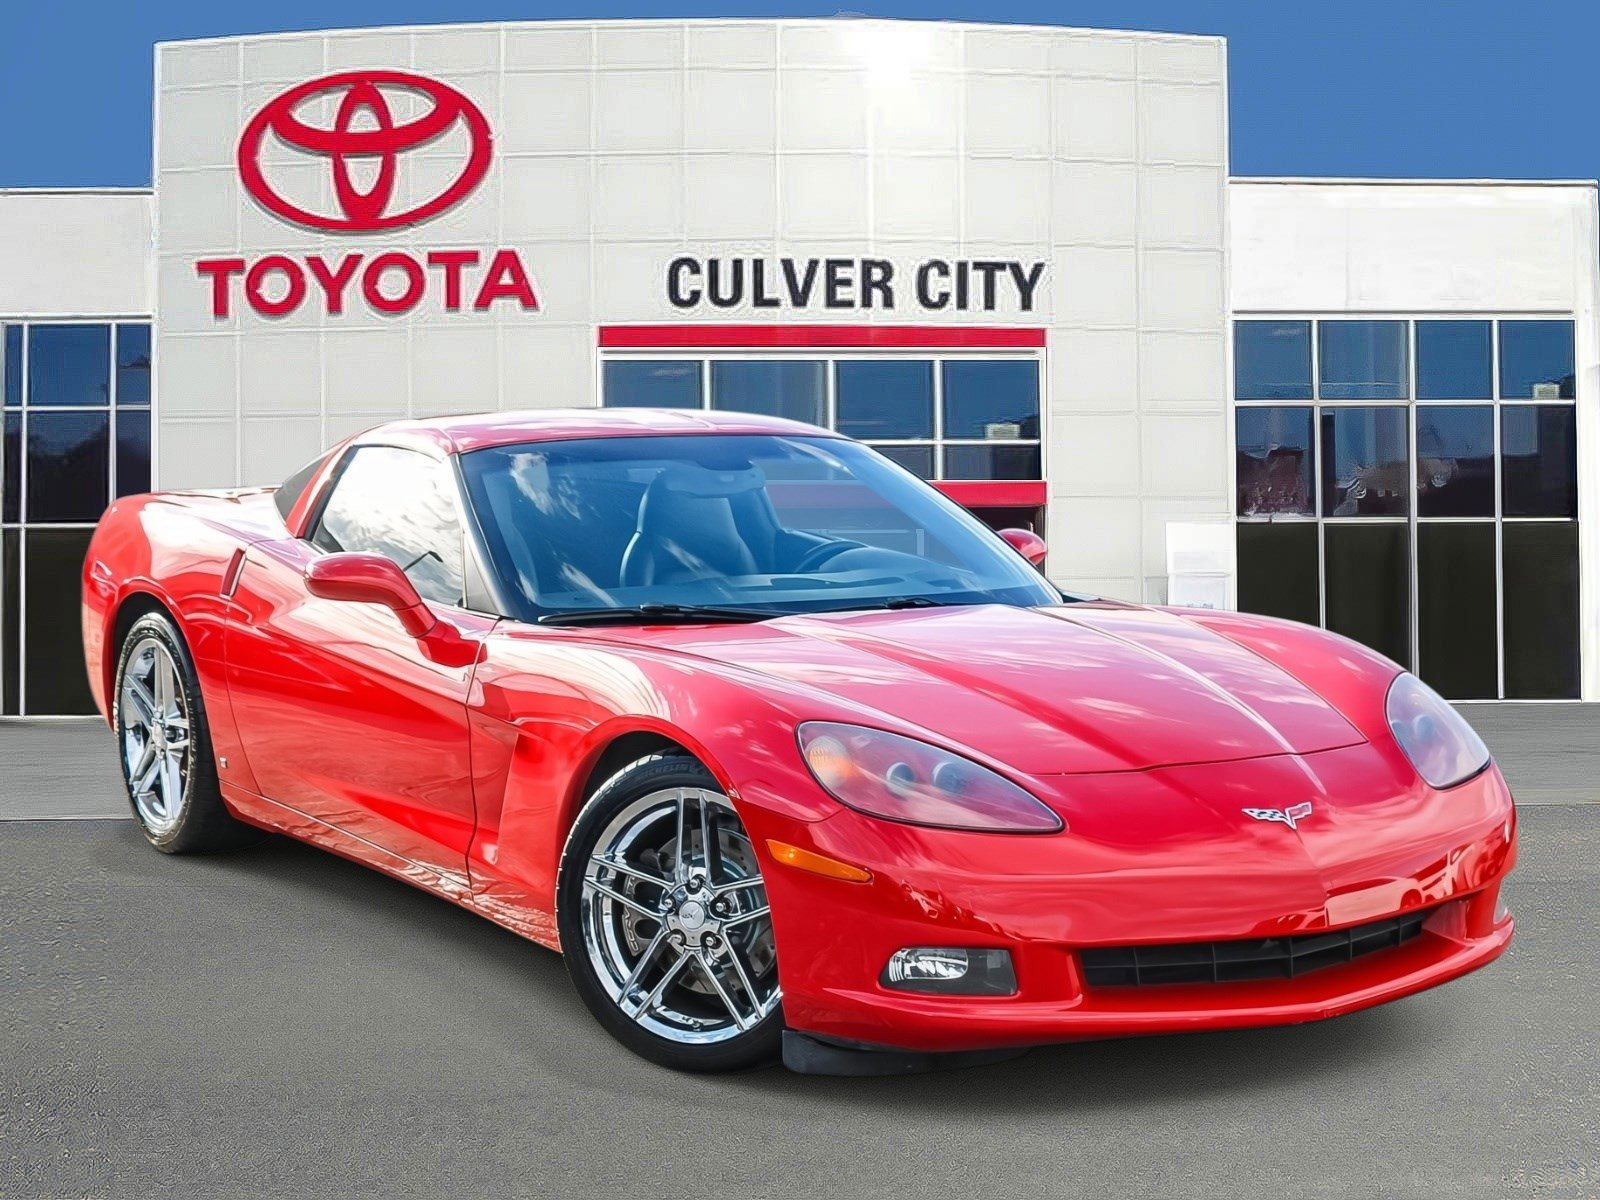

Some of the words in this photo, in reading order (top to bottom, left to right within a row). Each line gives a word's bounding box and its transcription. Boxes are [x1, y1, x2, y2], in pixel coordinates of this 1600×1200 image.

[196, 250, 538, 317] TOYOTA
[667, 257, 894, 309] CULVER
[916, 259, 1046, 311] CITY
[624, 876, 639, 951] CORVTT
